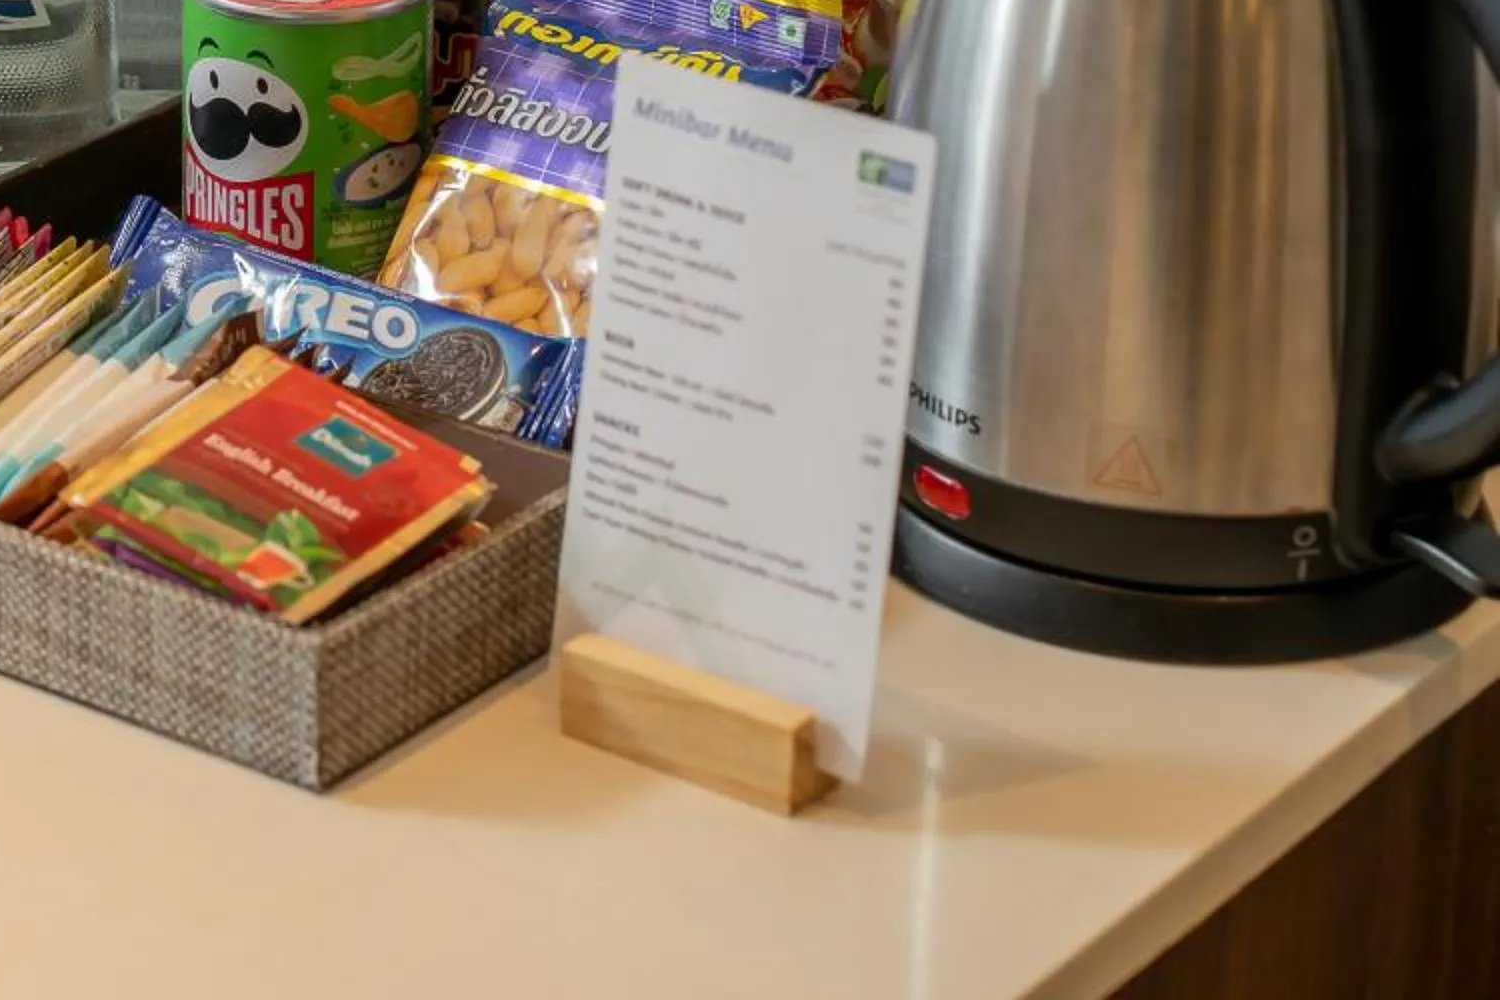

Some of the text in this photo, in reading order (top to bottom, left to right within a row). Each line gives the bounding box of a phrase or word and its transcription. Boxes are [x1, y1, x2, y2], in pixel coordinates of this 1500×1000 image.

[634, 97, 794, 164] Minibar Menu
[186, 152, 305, 250] PRINGLES
[187, 278, 417, 350] OREO
[909, 380, 982, 435] PHILIPS
[203, 433, 360, 521] English Breakfast
